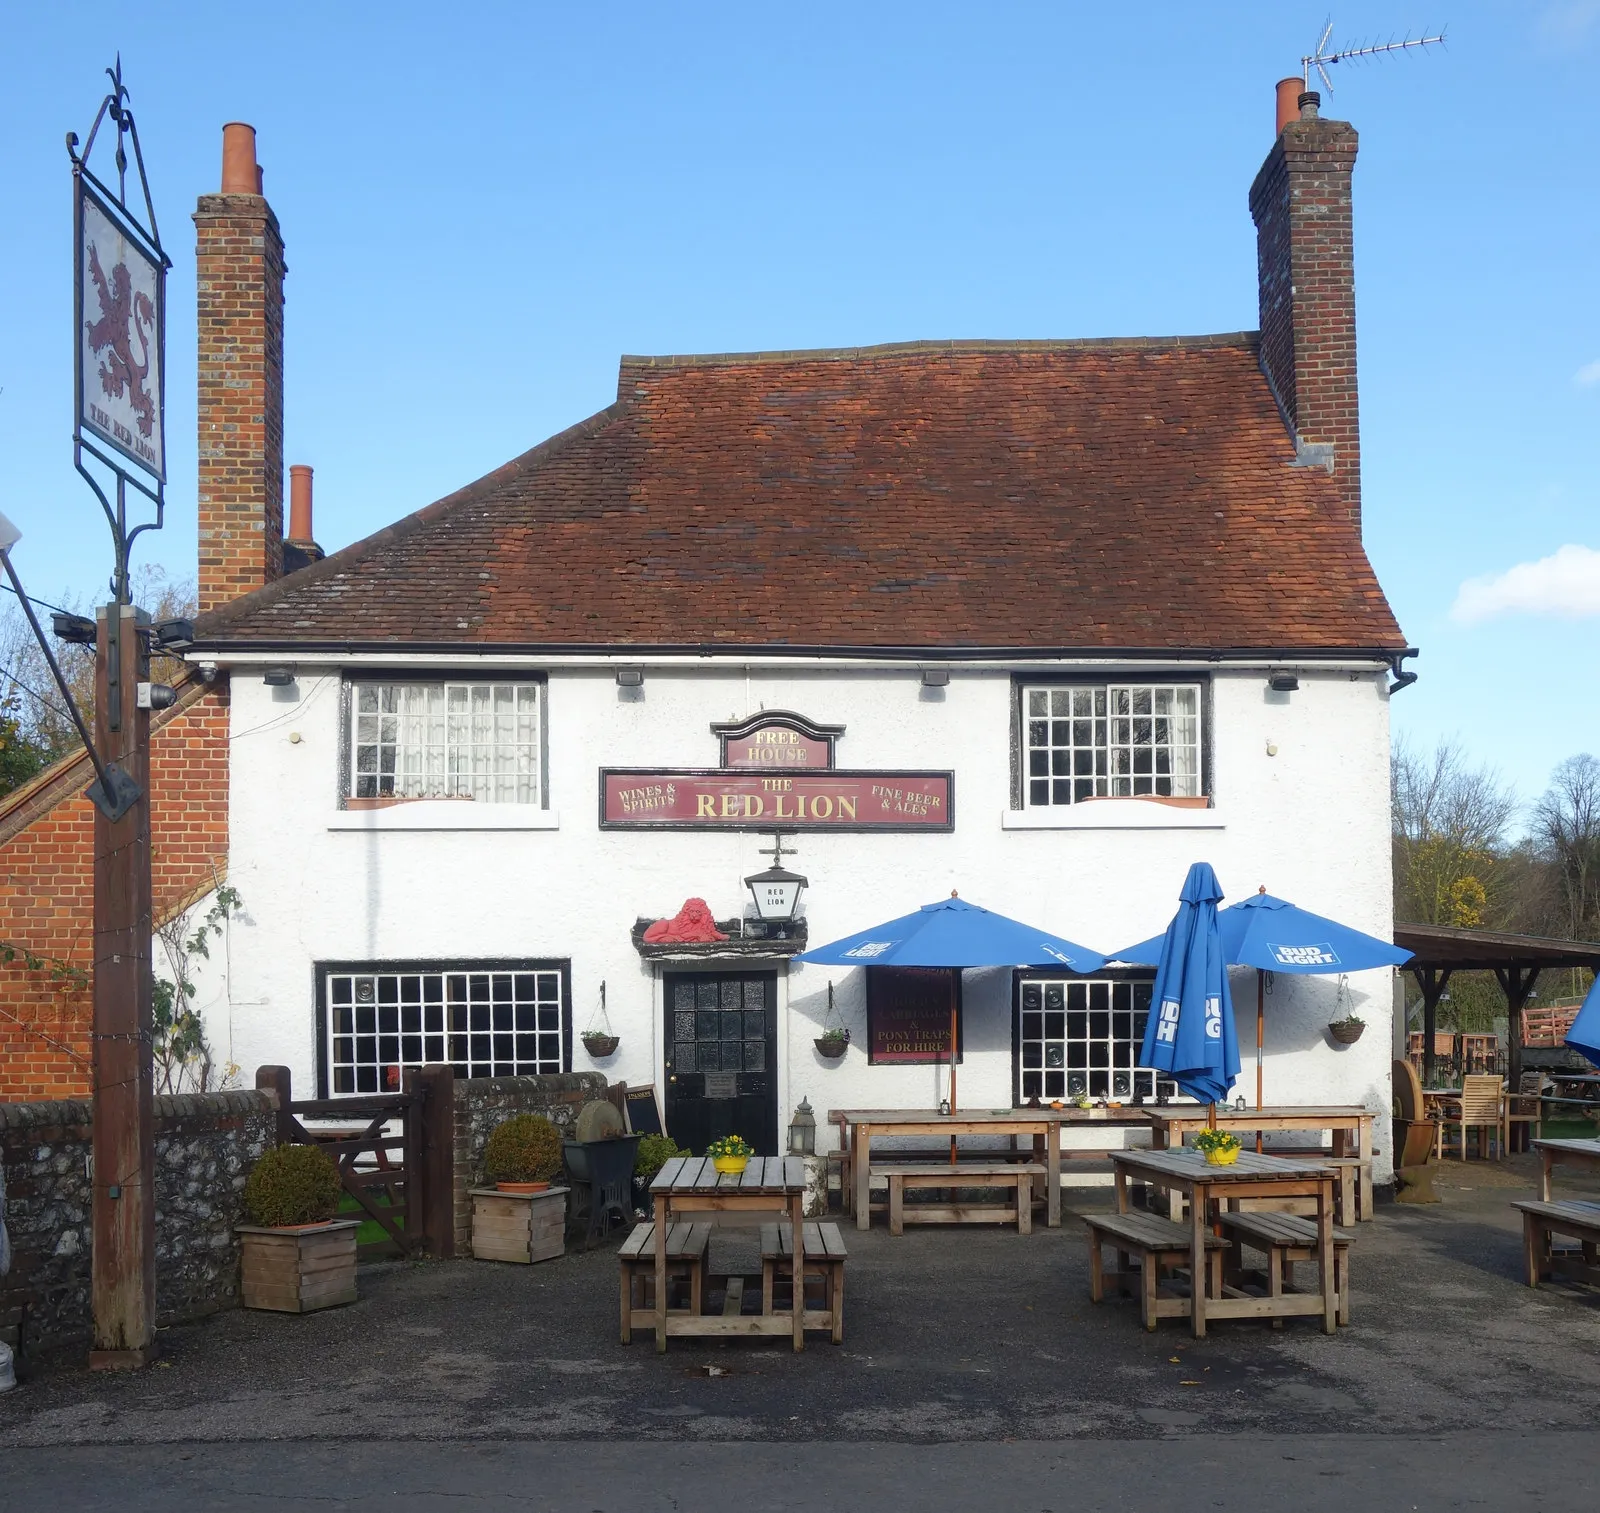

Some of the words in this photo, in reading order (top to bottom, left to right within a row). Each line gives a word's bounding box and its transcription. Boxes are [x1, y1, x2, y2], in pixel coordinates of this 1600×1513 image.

[90, 402, 110, 430] THE
[113, 418, 132, 446] RED
[134, 436, 156, 465] LION
[756, 731, 800, 744] FREE
[748, 748, 807, 761] HOUSE
[762, 779, 792, 791] THE
[618, 784, 662, 802] WINES
[666, 782, 676, 793] &
[872, 785, 902, 800] FINE
[906, 792, 940, 806] BEER
[624, 794, 675, 812] SPIRITS
[696, 794, 764, 817] RED
[774, 795, 858, 819] LION
[882, 798, 890, 808] &
[894, 801, 928, 816] ALES
[1278, 946, 1321, 956] BUD
[1276, 954, 1333, 964] LIGHT
[910, 1020, 920, 1029] &
[878, 1030, 910, 1040] PONY
[914, 1029, 952, 1040] TRAPS
[886, 1042, 910, 1052] FOR
[914, 1042, 944, 1052] HIRE
